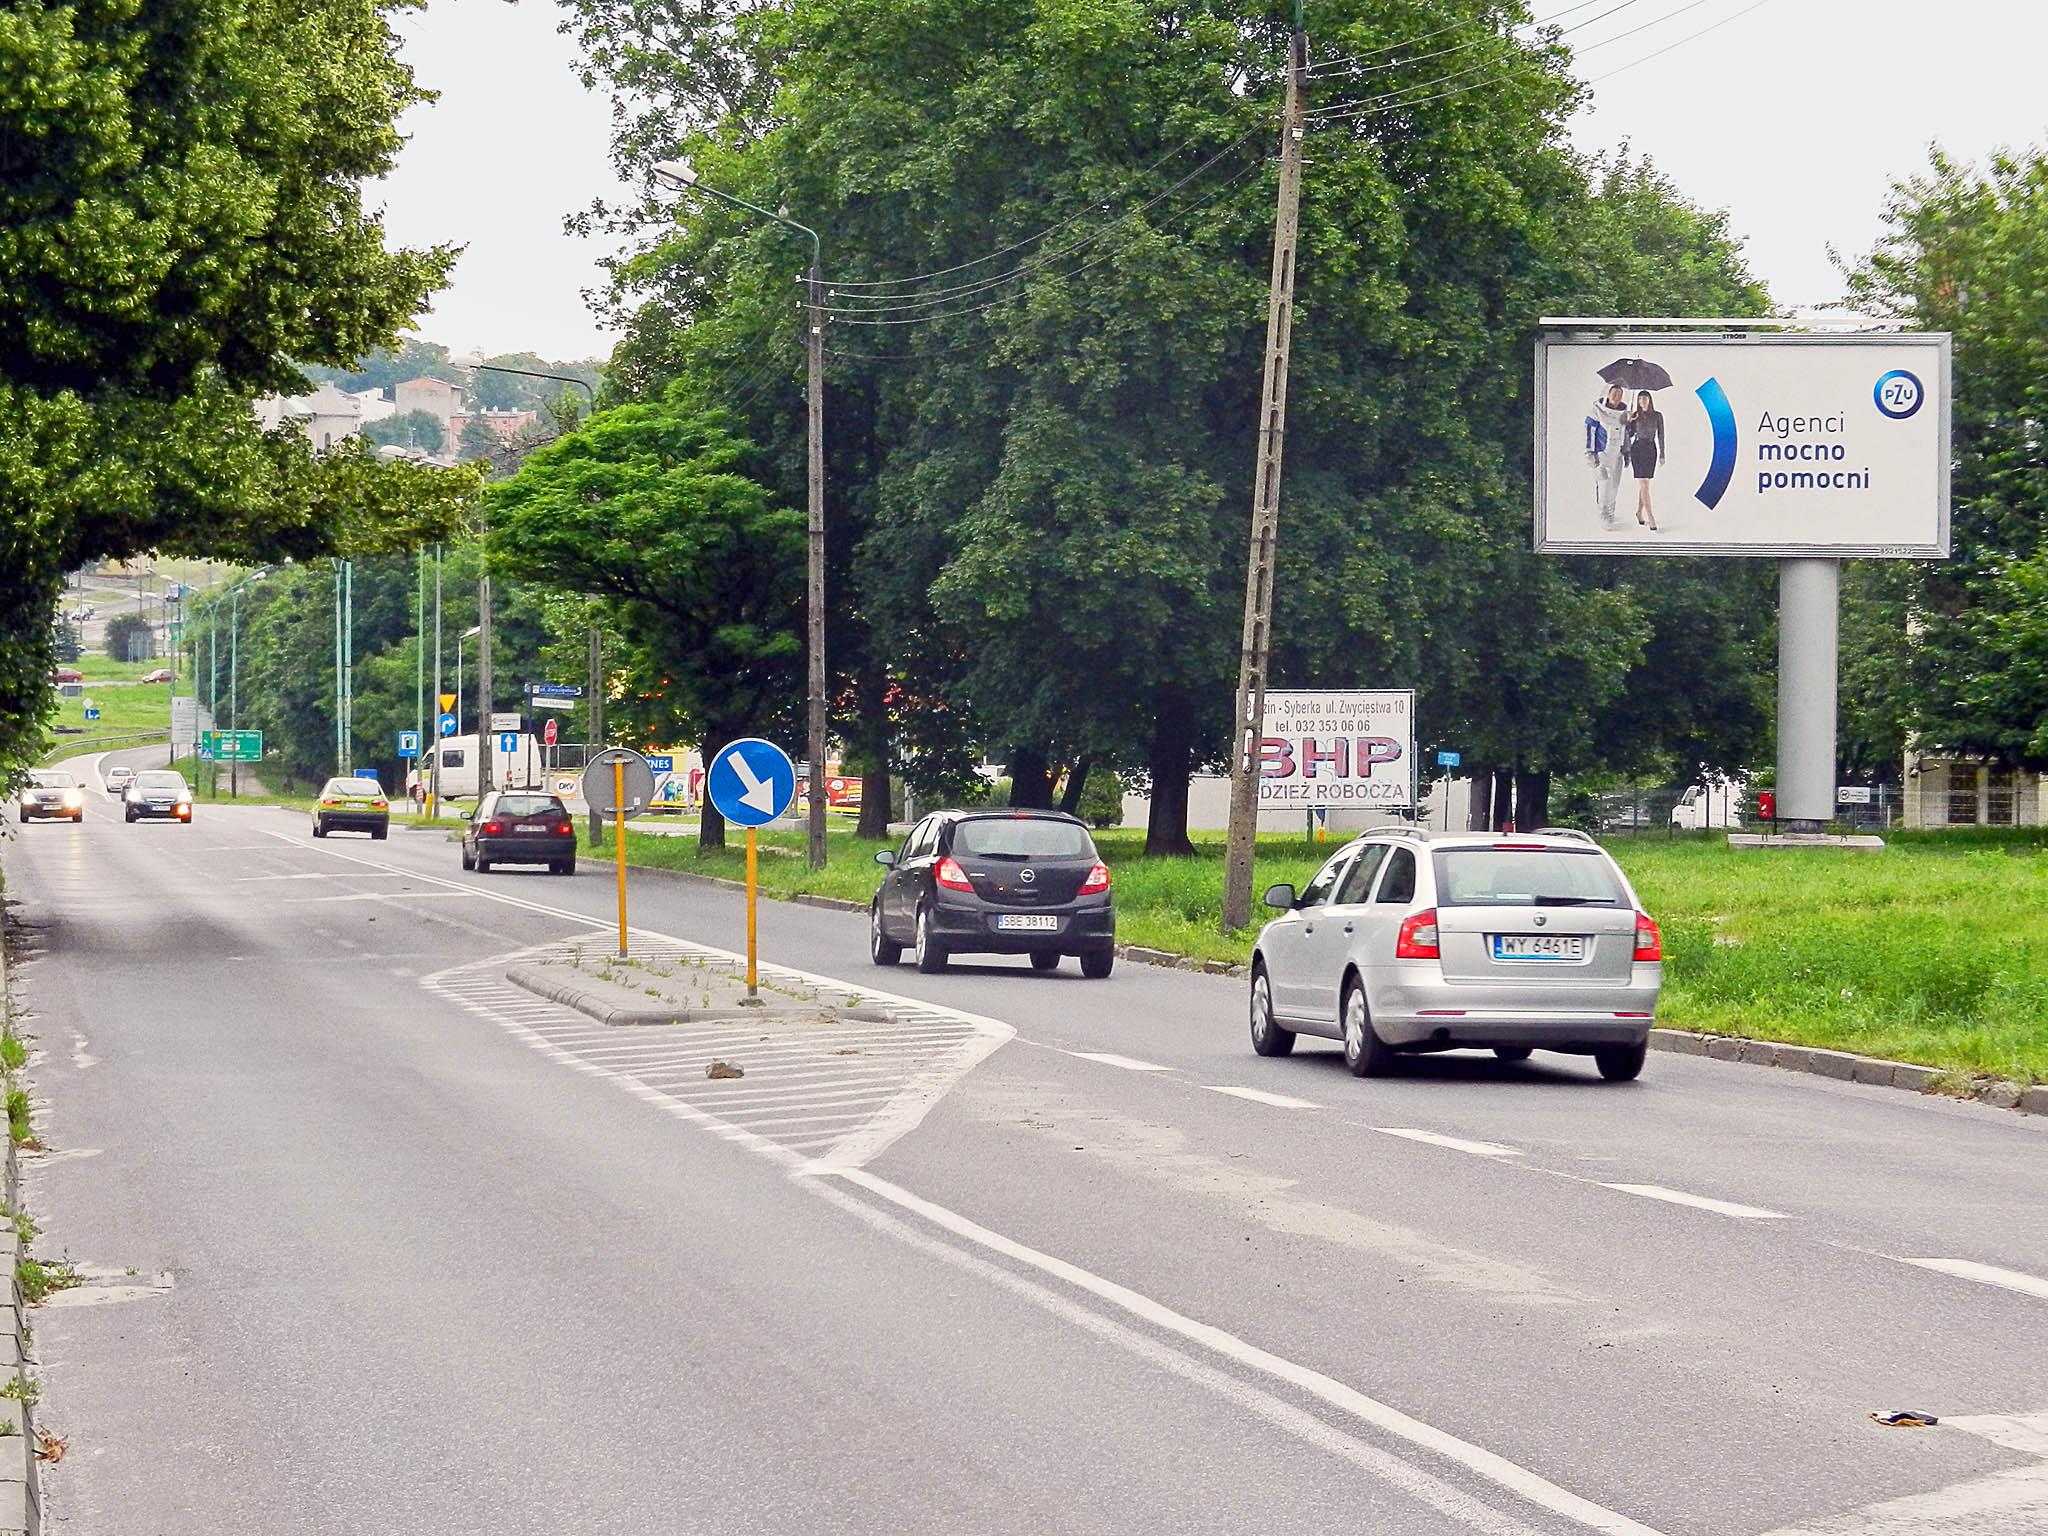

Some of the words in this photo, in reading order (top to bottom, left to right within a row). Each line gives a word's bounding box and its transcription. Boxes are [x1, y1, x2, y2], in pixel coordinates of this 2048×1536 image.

[1885, 384, 1913, 405] PZU
[1758, 411, 1844, 439] Agenci
[1759, 444, 1845, 460] mocno
[1758, 467, 1869, 493] pomocni
[1284, 700, 1321, 717] Syberka
[1325, 700, 1337, 714] ul.
[1339, 700, 1391, 718] Zwycięstwa
[1394, 700, 1404, 714] 10
[1275, 720, 1292, 732] tel.
[1295, 720, 1315, 732] 032
[1318, 720, 1338, 732] 353
[1341, 720, 1354, 732] 06
[1357, 720, 1370, 732] 06
[1248, 736, 1402, 778] BHP
[558, 781, 575, 791] DKV
[1260, 782, 1311, 800] DZIEŻ
[1316, 784, 1405, 800] ROBOCZA
[1004, 915, 1022, 927] SBE
[1026, 916, 1057, 928] 38112
[1504, 937, 1526, 953] WY
